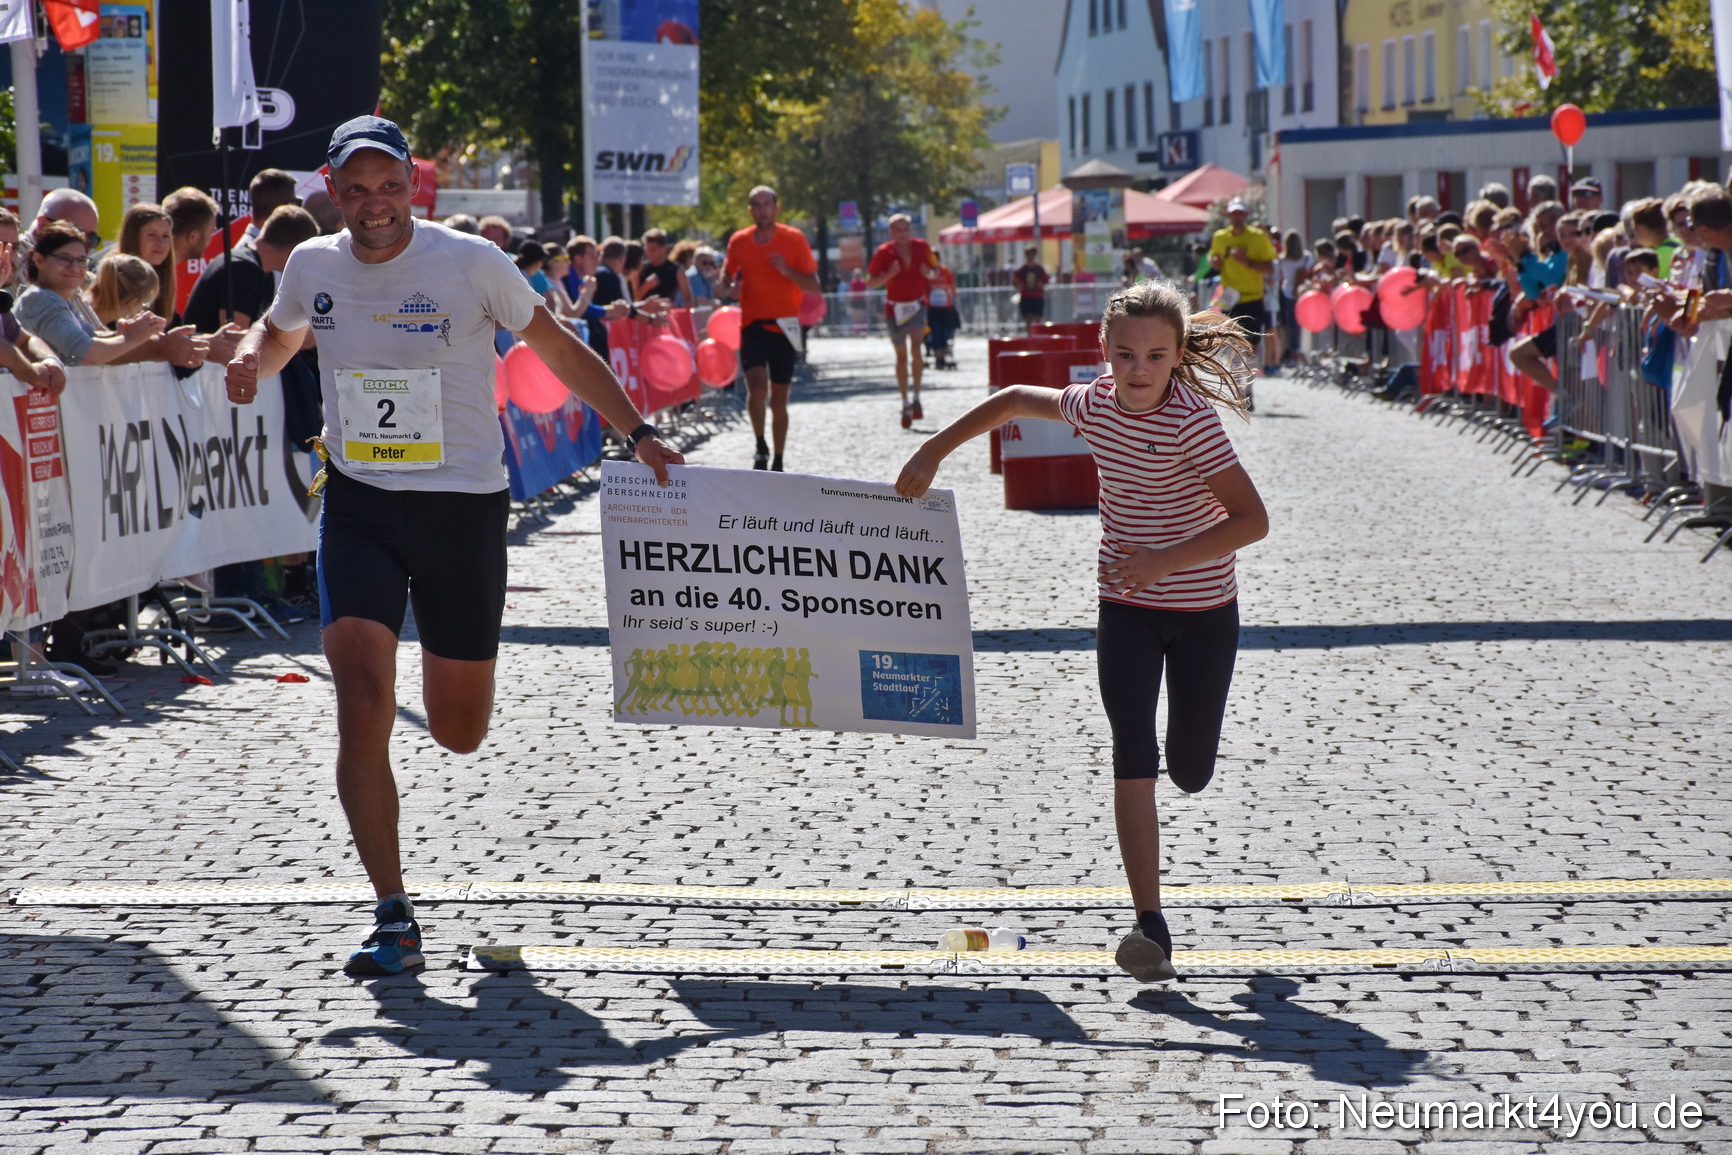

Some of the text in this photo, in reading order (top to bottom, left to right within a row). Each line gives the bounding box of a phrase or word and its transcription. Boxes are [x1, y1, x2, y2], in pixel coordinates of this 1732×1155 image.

[594, 150, 666, 173] swn
[311, 316, 335, 325] PARTL
[363, 379, 409, 390] BOCK
[377, 398, 397, 429] 2
[359, 432, 379, 440] PARTL
[372, 446, 406, 459] Peter
[607, 475, 687, 488] BERSCHNDER
[607, 488, 687, 500] BERSCHNEIDER
[820, 487, 914, 504] funrunners-neumarkt
[607, 503, 688, 515] ARCHITEKTEN BDA
[608, 515, 688, 526] INNENARCHITEKTEN
[718, 514, 944, 543] Er läuft und läuft und läuft...
[618, 539, 948, 586] HERZLICHEN DANK
[630, 585, 943, 621] an die 40. Sponsoren
[622, 615, 645, 630] Ihr
[704, 618, 756, 635] super!
[871, 654, 898, 670] 19.
[872, 670, 931, 682] Neumarkter
[872, 682, 920, 695] Stadtlauf
